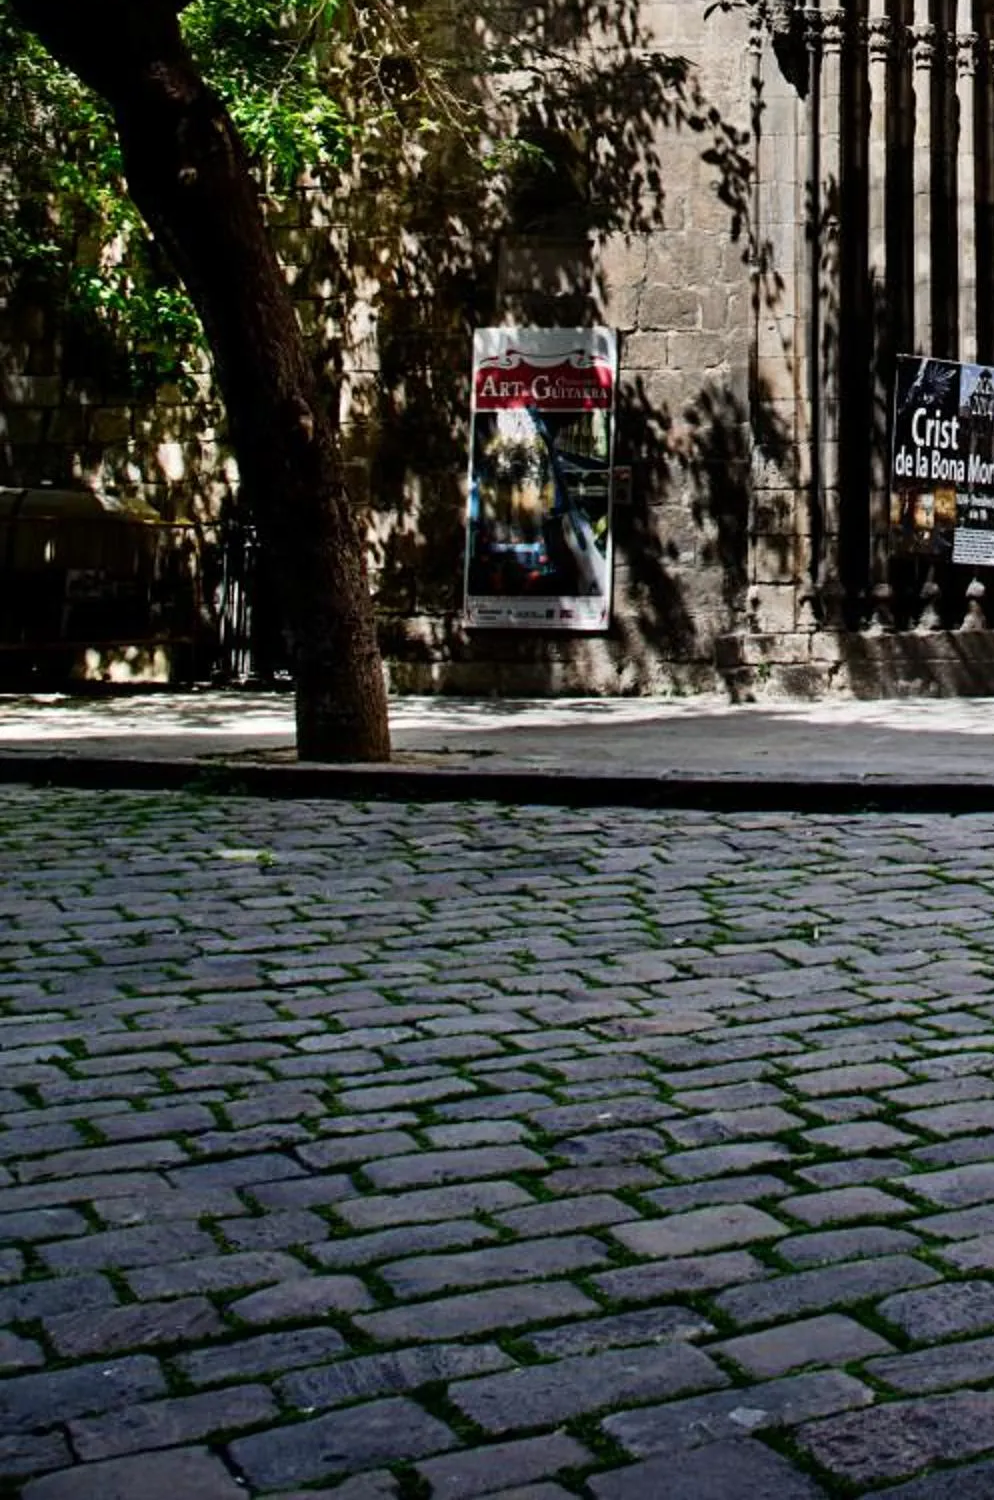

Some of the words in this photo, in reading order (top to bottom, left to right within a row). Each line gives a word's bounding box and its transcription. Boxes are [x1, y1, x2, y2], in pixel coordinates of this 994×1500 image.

[480, 375, 521, 397] ART
[911, 407, 960, 450] Crist
[895, 445, 914, 477] de
[915, 448, 928, 479] la
[931, 450, 965, 482] Bona
